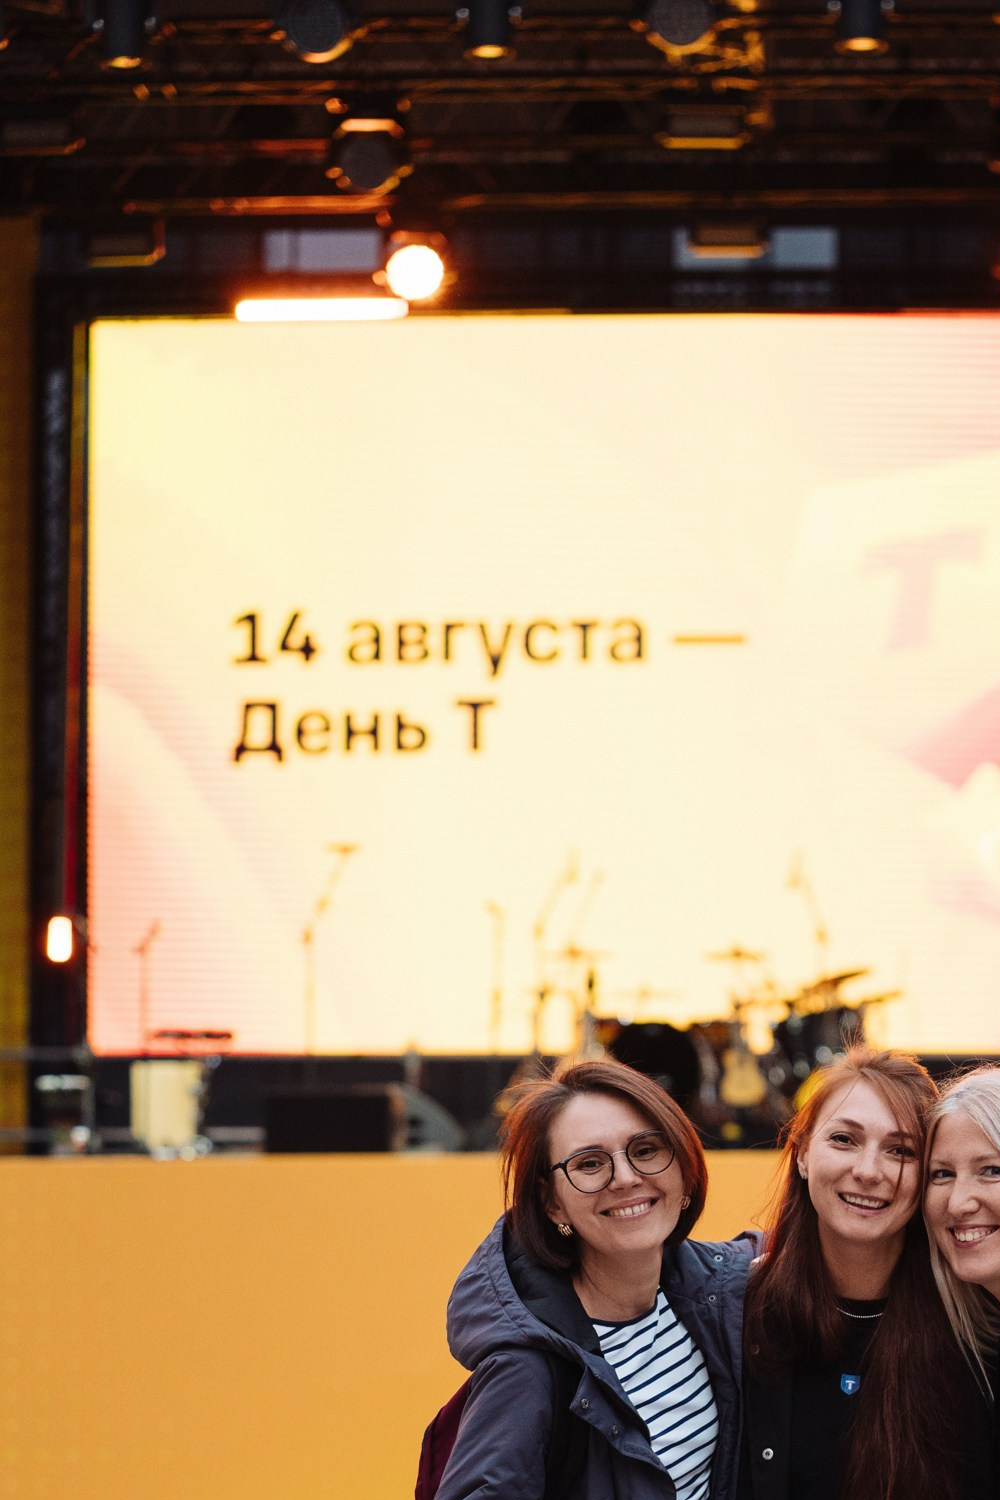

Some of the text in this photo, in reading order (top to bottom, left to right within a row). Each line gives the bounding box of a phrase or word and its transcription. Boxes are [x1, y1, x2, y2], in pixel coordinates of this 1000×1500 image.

[231, 608, 320, 667] 14
[344, 617, 647, 680] августа
[230, 697, 498, 767] День Т
